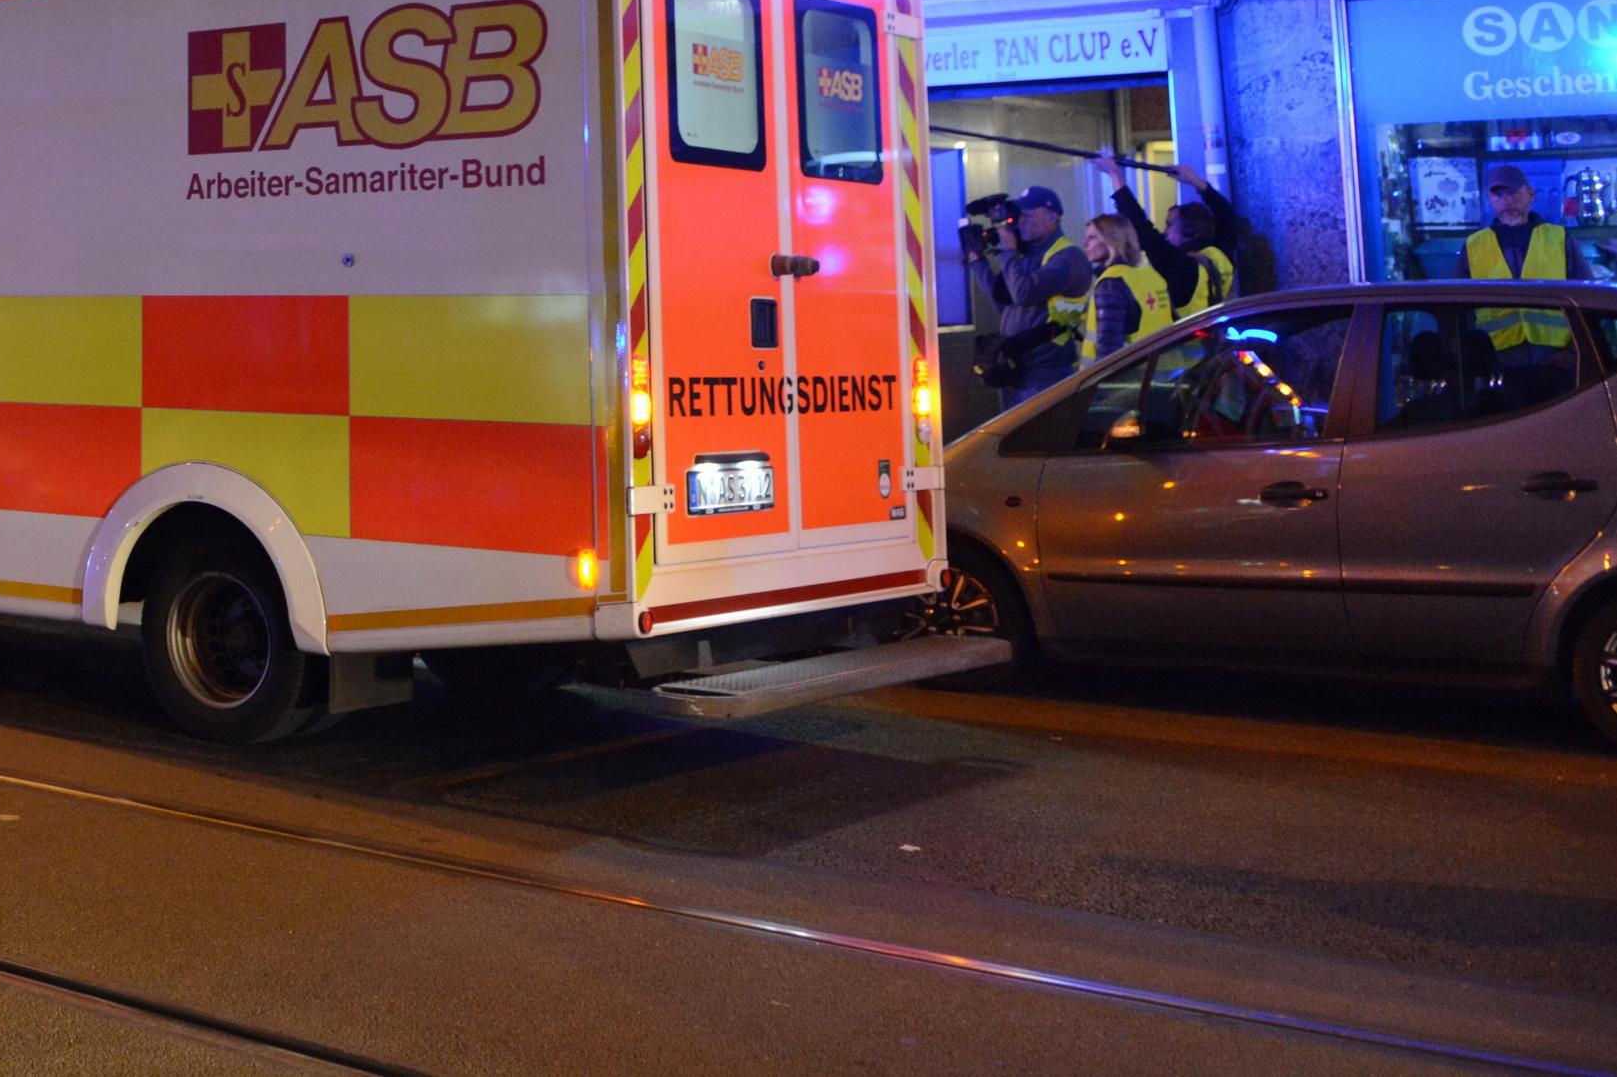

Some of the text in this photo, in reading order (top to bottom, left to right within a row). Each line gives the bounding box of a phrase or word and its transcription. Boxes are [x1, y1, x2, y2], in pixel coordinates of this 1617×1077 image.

[705, 45, 745, 81] ASB
[994, 35, 1039, 67] FAN
[1048, 31, 1112, 64] CLUP
[829, 69, 863, 101] ASB
[185, 155, 547, 201] Arbeiter-Samariter-Bund
[668, 374, 897, 418] RETTUNGSDIENST
[718, 474, 736, 504] AS
